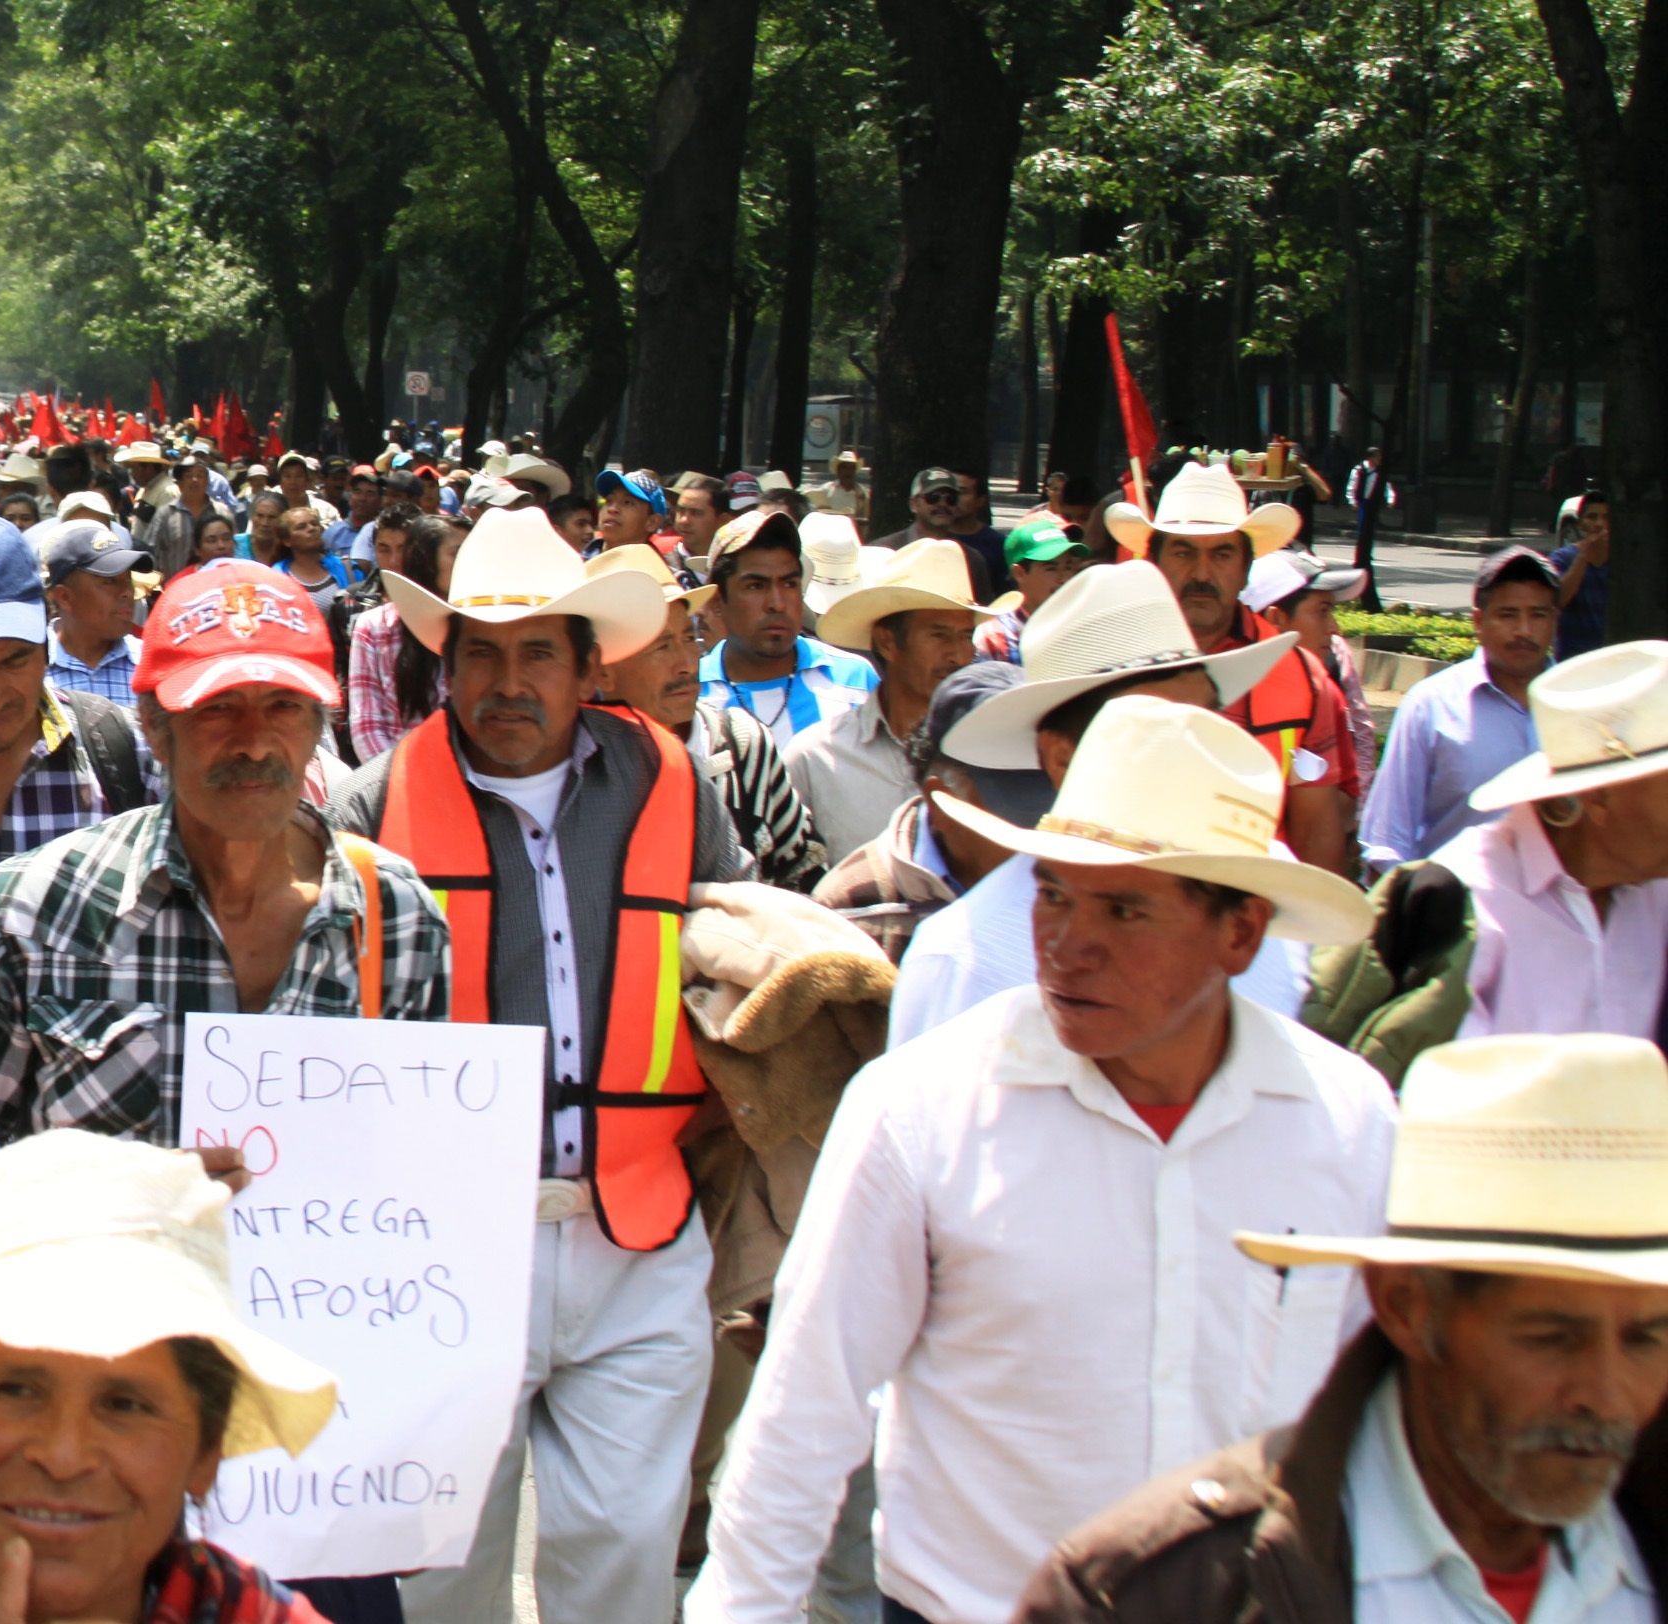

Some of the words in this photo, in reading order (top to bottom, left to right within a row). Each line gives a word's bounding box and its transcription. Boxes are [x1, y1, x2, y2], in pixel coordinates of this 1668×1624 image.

[166, 594, 310, 645] TEAS
[204, 1024, 500, 1112] SEDATU
[232, 1197, 431, 1240] NTREGA
[248, 1263, 469, 1348] APOYOS
